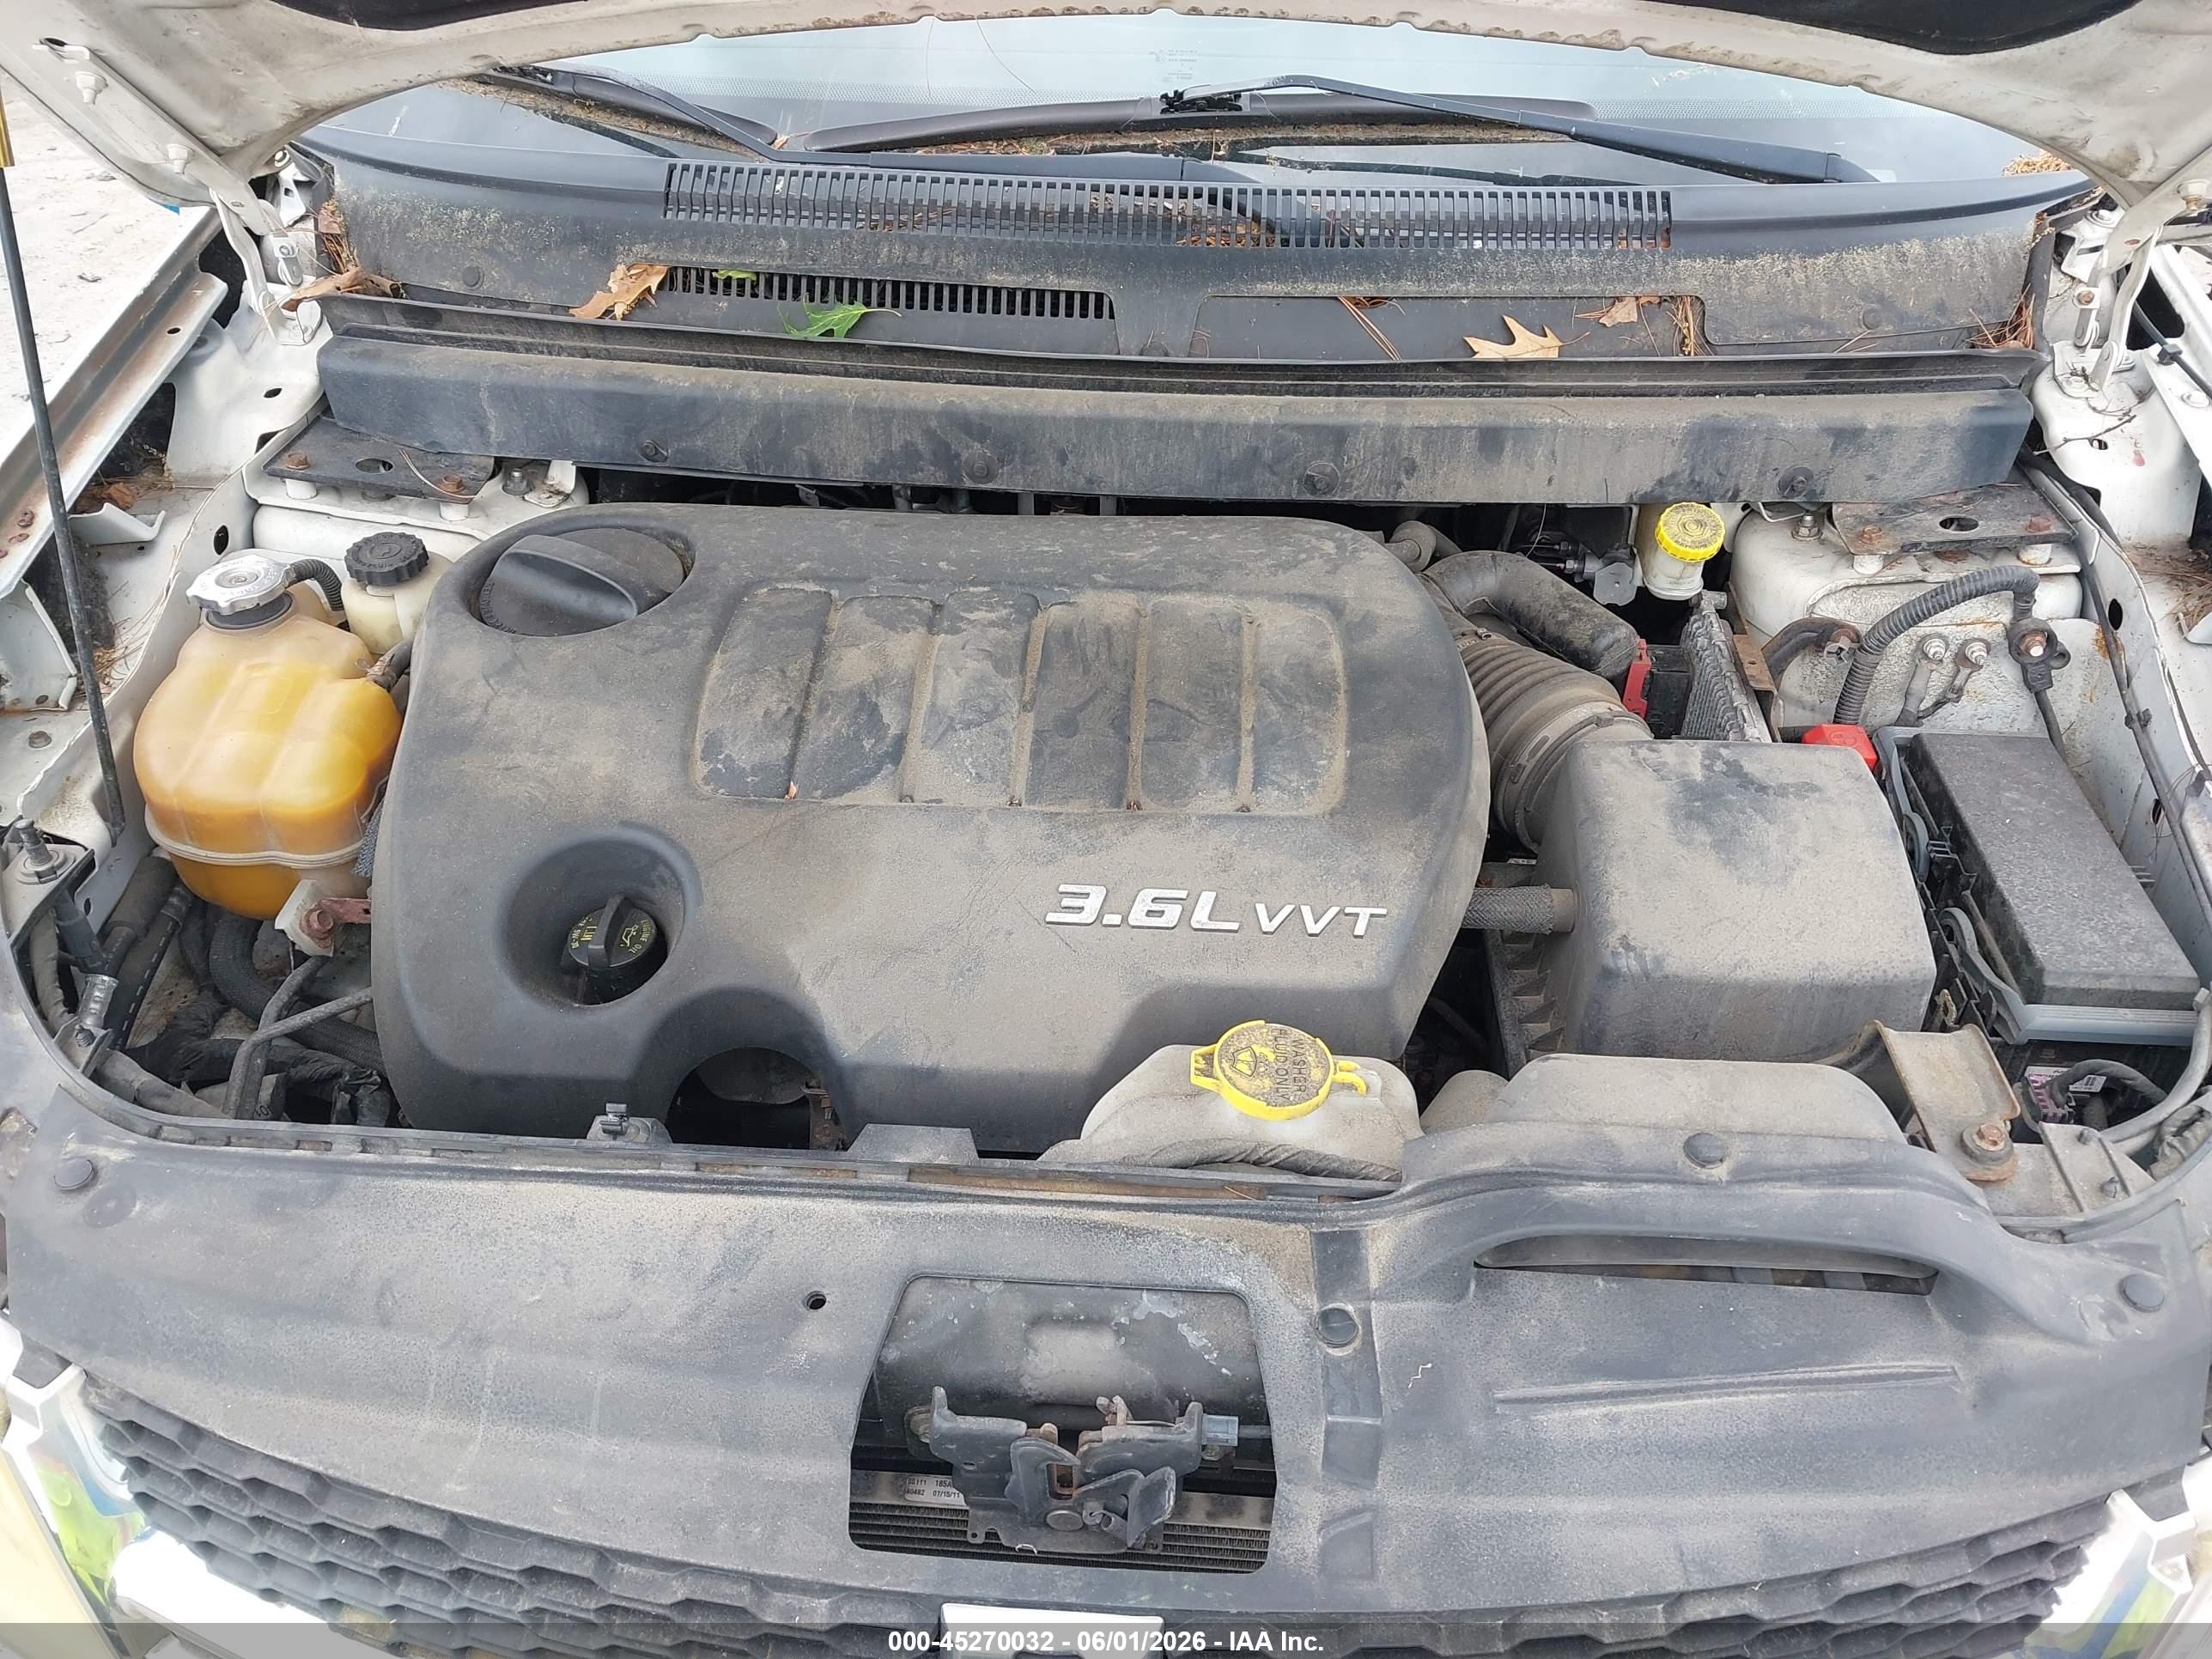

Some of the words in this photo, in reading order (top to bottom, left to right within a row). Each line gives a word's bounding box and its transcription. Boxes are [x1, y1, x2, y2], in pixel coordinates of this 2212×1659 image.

[1045, 884, 1240, 933] 3.6L
[1255, 902, 1388, 939] VVT
[628, 944, 642, 954] OIL
[1270, 1029, 1287, 1064] FLUID
[1291, 1039, 1307, 1093] WASHER
[1275, 1068, 1292, 1103] ONLY
[933, 1490, 960, 1498] 07/15/11
